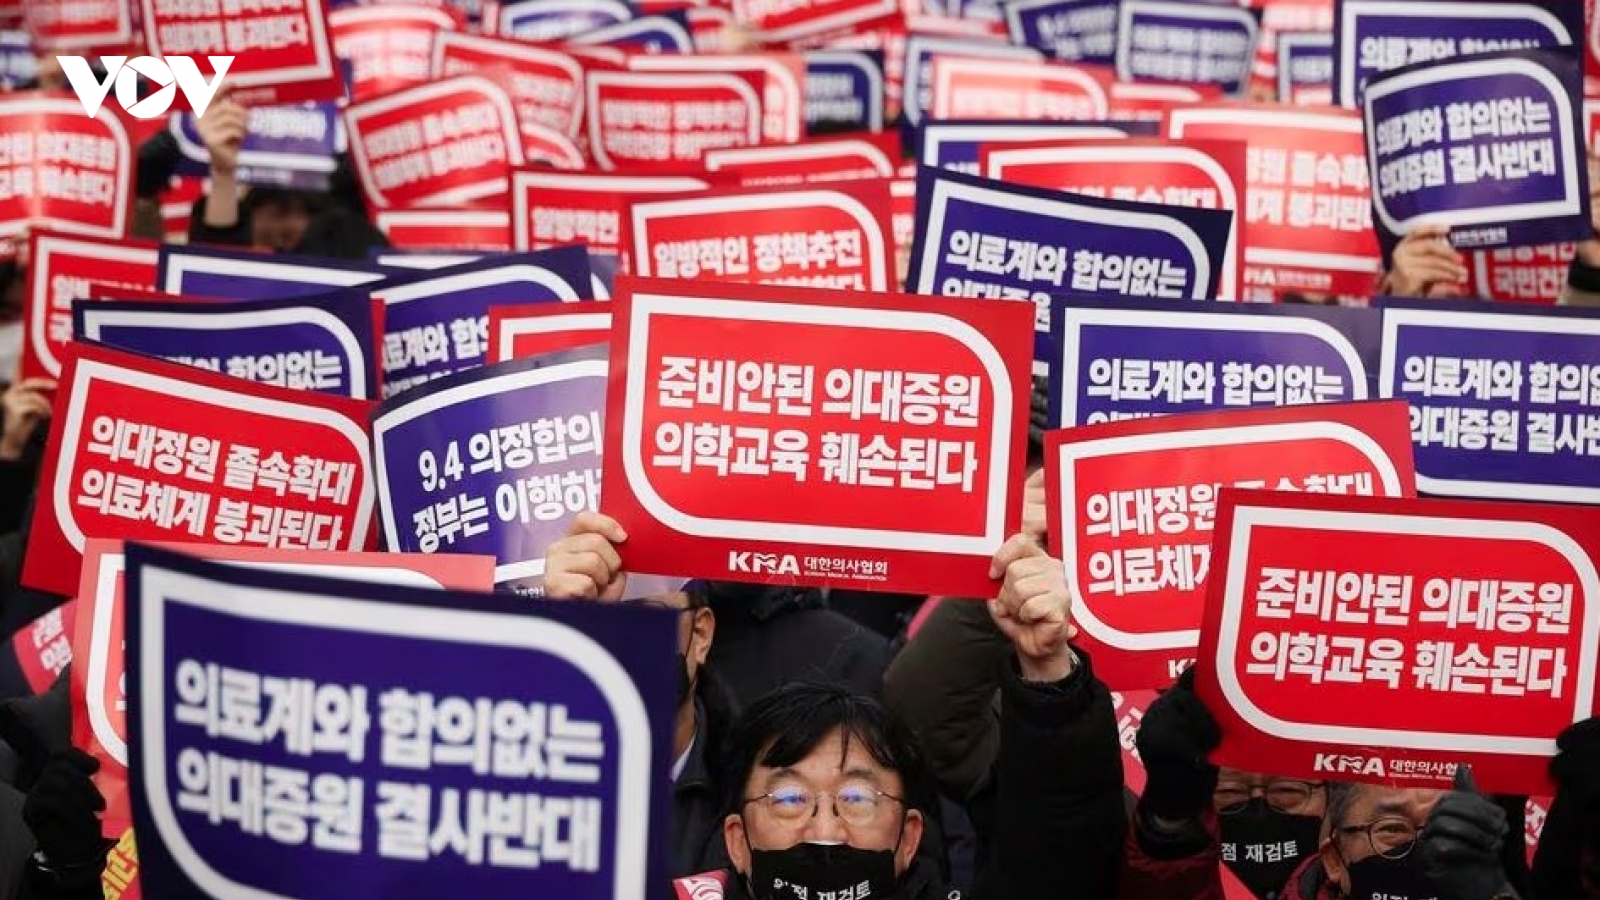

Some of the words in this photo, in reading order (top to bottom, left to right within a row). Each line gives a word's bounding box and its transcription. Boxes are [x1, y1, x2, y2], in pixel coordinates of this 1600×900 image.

[1445, 96, 1551, 141] 합의없는
[1449, 137, 1557, 185] 결사반대
[654, 236, 749, 279] 일방적인
[752, 229, 863, 272] 정책추진
[946, 229, 1068, 287] 의료계와
[1071, 249, 1187, 299] 합의없는
[382, 322, 449, 373] 료계와
[1086, 358, 1217, 405] 의료계와
[1221, 361, 1344, 406] 합의없는
[1401, 355, 1523, 402] 의료계와
[1528, 360, 1600, 407] 합의
[657, 356, 815, 417] 준비안된
[822, 368, 982, 428] 의대증원
[87, 416, 220, 484] 의대정원
[223, 444, 357, 506] 졸속확대
[418, 441, 465, 493] 9.4
[468, 410, 603, 475] 의정합의
[653, 421, 811, 483] 의학교육
[818, 431, 978, 494] 훼손된다
[1408, 403, 1520, 453] 의대증원
[1527, 412, 1600, 457] 결사반
[77, 468, 211, 537] 의료체계
[213, 497, 344, 550] 붕괴된다
[412, 493, 490, 554] 정부는
[495, 468, 602, 524] 이행하
[803, 555, 888, 575] 대한의사협회
[1255, 566, 1413, 626] 준비안된
[1417, 577, 1574, 635] 의대증원
[1245, 631, 1404, 690] 의학교육
[1411, 640, 1567, 700] 훼손된다
[175, 657, 370, 763] 의료계와
[379, 687, 605, 783] 합의없는
[1389, 758, 1472, 778] 대한의사협
[177, 748, 364, 855] 의대증원
[375, 780, 601, 873] 결사반대
[1220, 842, 1237, 862] 점
[1245, 840, 1299, 863] 재검토
